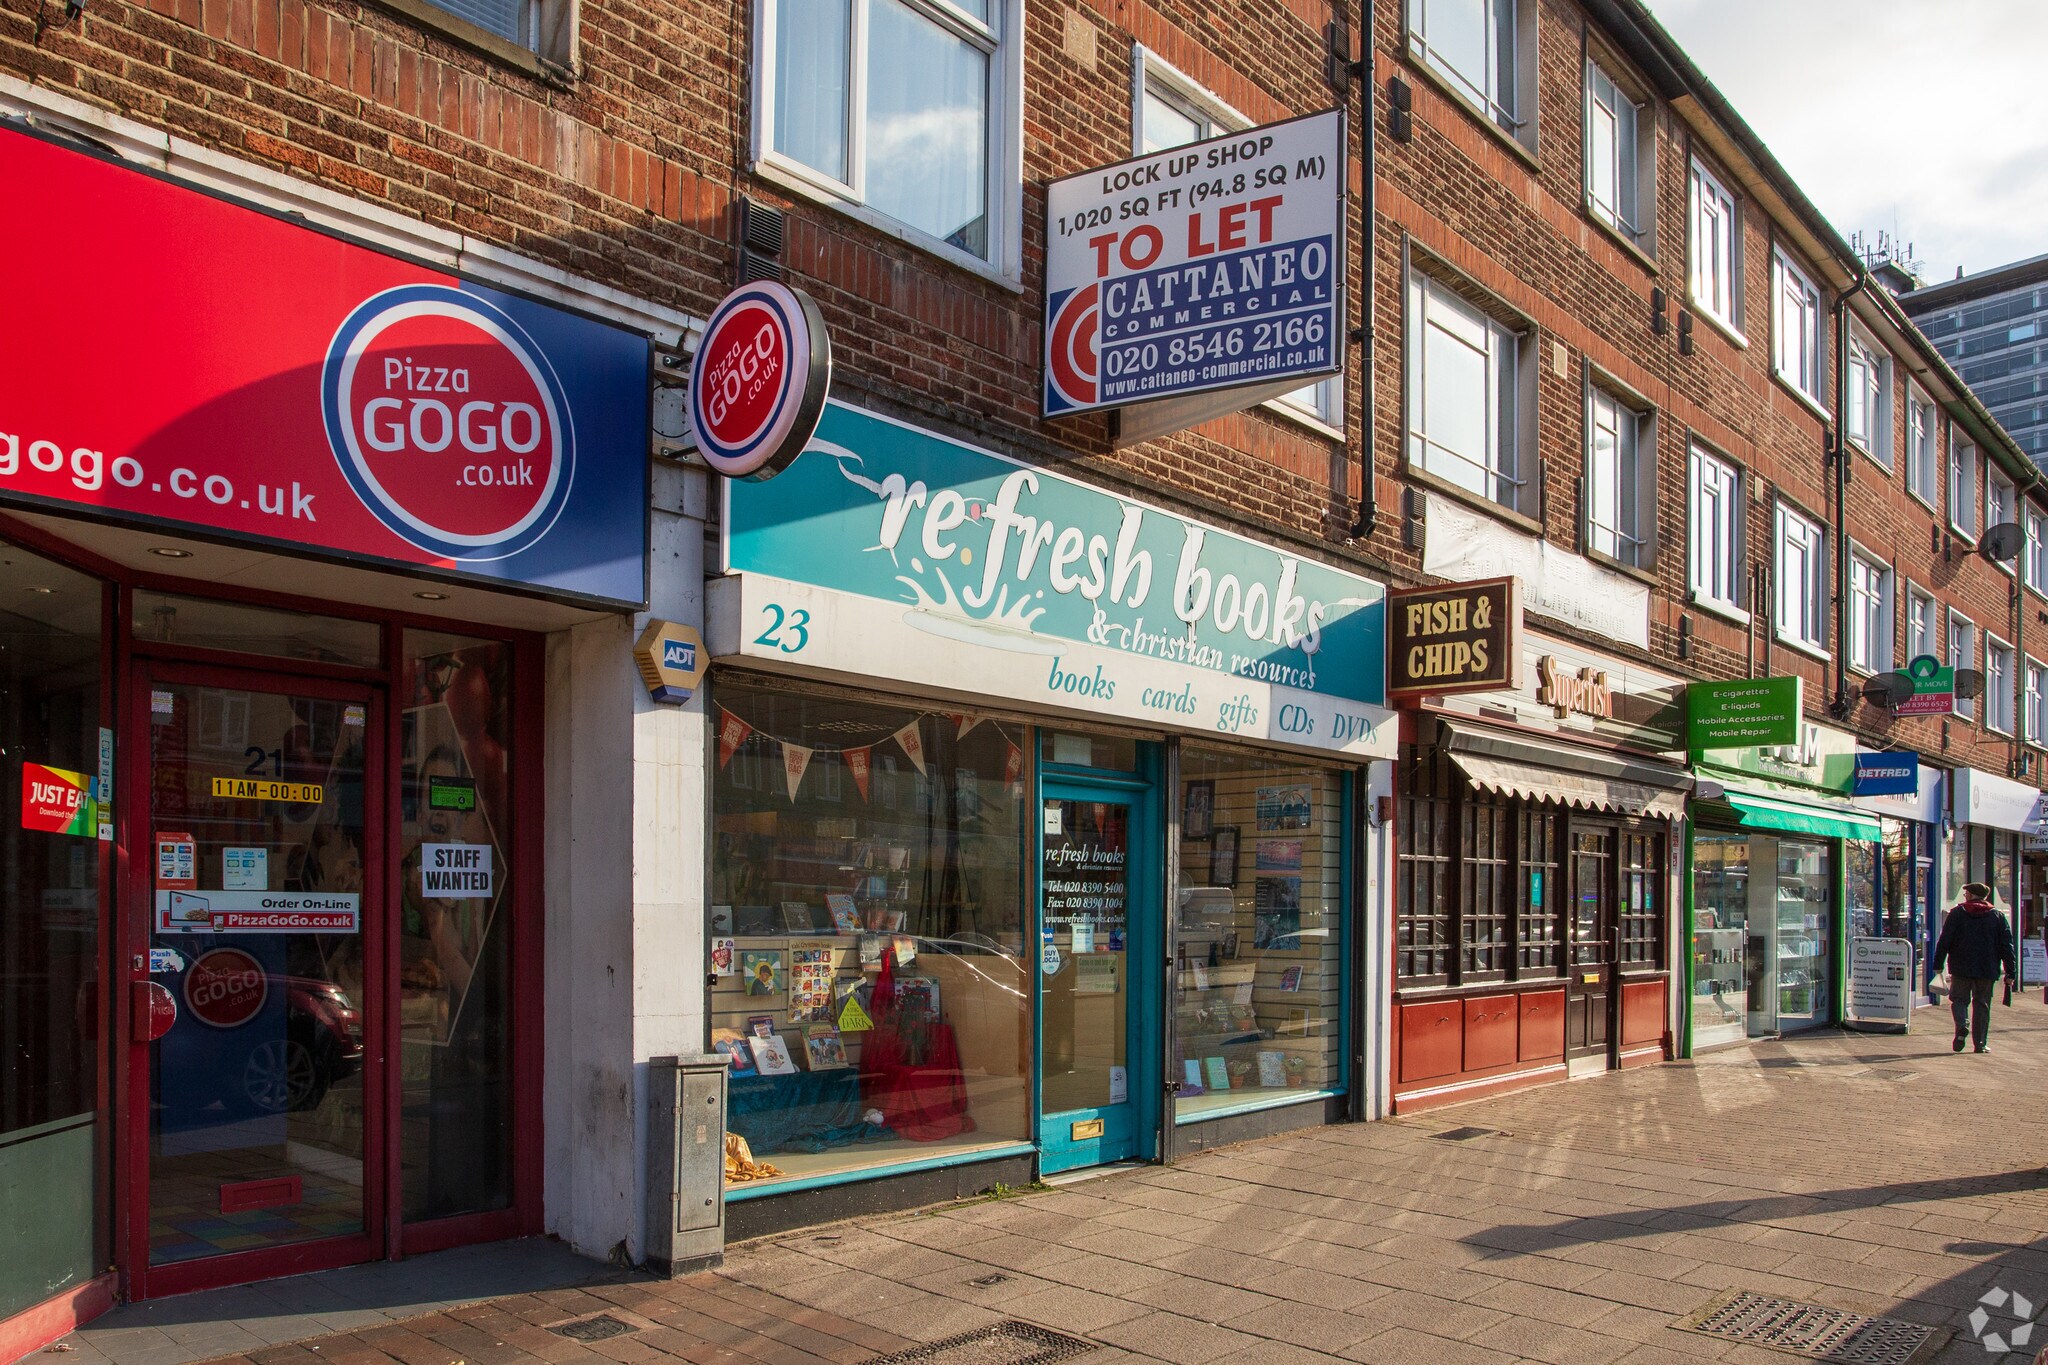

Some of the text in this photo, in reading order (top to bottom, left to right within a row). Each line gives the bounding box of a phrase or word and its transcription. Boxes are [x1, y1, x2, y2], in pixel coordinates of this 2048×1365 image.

[1102, 137, 1273, 194] LOCK UP SHOP
[1059, 155, 1326, 237] 1,020 SQ FT (94.8 SQ M)
[1089, 195, 1283, 278] TO LET
[1106, 242, 1326, 318] CATTANEO
[1106, 286, 1325, 337] COMMERCIAL
[1106, 314, 1324, 377] 020 8546 2166
[384, 356, 469, 393] Pizza
[709, 341, 741, 391] Pizza
[709, 323, 775, 426] GOGO
[747, 357, 778, 405] .co.uk
[1105, 345, 1324, 396] www.cattaneo-commercial.co.uk
[363, 397, 541, 453] GOGO
[456, 459, 533, 486] .co.uk
[1173, 522, 1324, 655] books
[753, 602, 810, 654] 23
[1407, 595, 1491, 637] FISH &
[664, 644, 695, 667] ADT
[1087, 609, 1317, 689] & christian resources
[1408, 639, 1488, 678] CHIPS
[1048, 657, 1378, 745] books cards gifts CDs DVDs
[1543, 655, 1612, 718] Superfish
[1713, 688, 1770, 698] E-cigarettes
[1697, 714, 1785, 725] Mobile Accessories
[1721, 702, 1760, 710] E-liquids
[1741, 728, 1771, 736] Repair
[244, 746, 282, 777] 21
[1858, 768, 1911, 778] BETFRED
[30, 782, 92, 809] JUST EAT
[216, 780, 321, 801] 11AM-00:00
[39, 807, 65, 818] Download
[435, 849, 480, 868] STAFF
[1092, 844, 1125, 864] books
[426, 871, 489, 890] WANTED
[1048, 880, 1124, 894] Tel: 020 8390 5400
[262, 899, 351, 909] Order On-Line
[1047, 897, 1123, 908] Fax: 020 8390 1004
[229, 914, 351, 926] PizzaGoGo.co.uk
[193, 969, 259, 1006] GOGO
[199, 966, 229, 984] Pizza
[229, 990, 259, 1007] .co.uk
[841, 1017, 869, 1029] DARK
